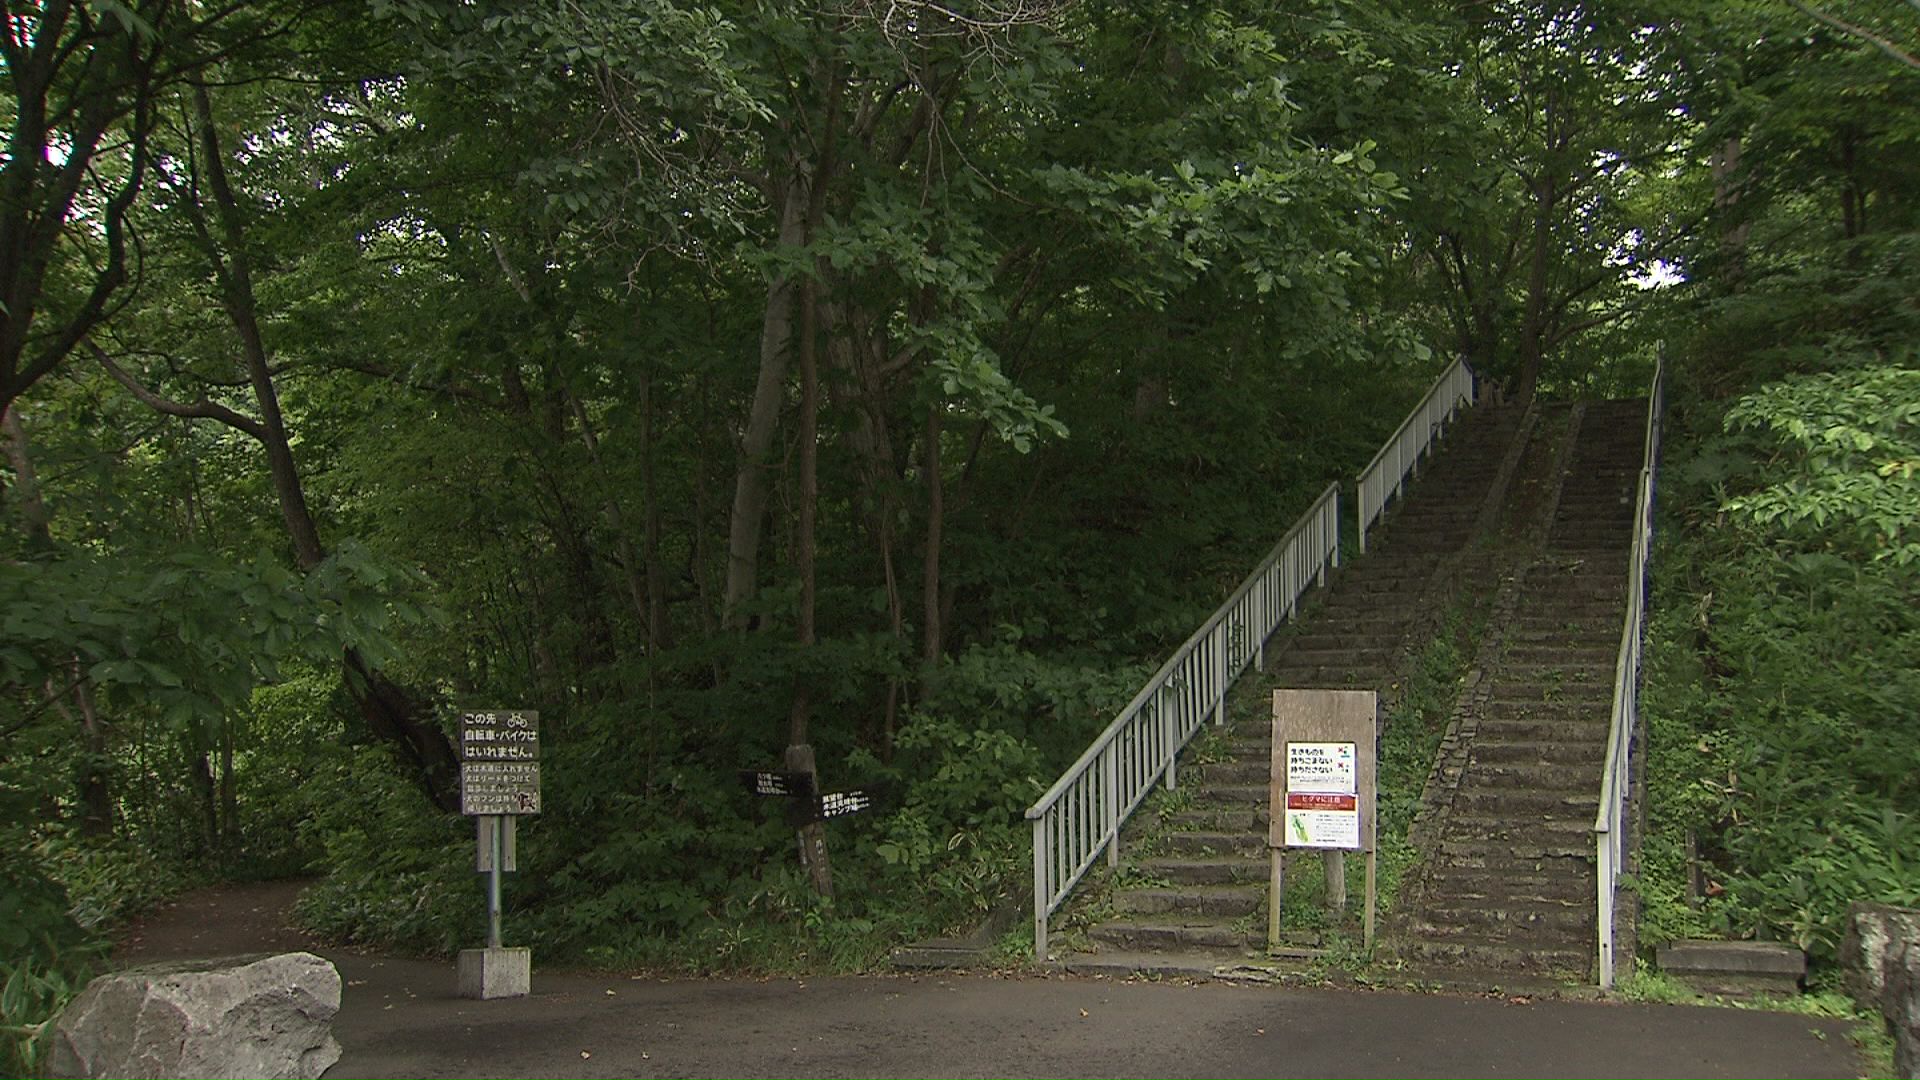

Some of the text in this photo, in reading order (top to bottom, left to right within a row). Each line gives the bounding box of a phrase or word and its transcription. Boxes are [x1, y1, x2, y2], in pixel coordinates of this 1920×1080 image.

[464, 713, 496, 725] この先
[464, 729, 537, 742] 自転車・バイクは
[465, 746, 533, 759] はいれません。
[1290, 748, 1324, 756] 生きものを
[1290, 757, 1333, 765] 持ちこまない
[1290, 766, 1333, 774] 持ちださない
